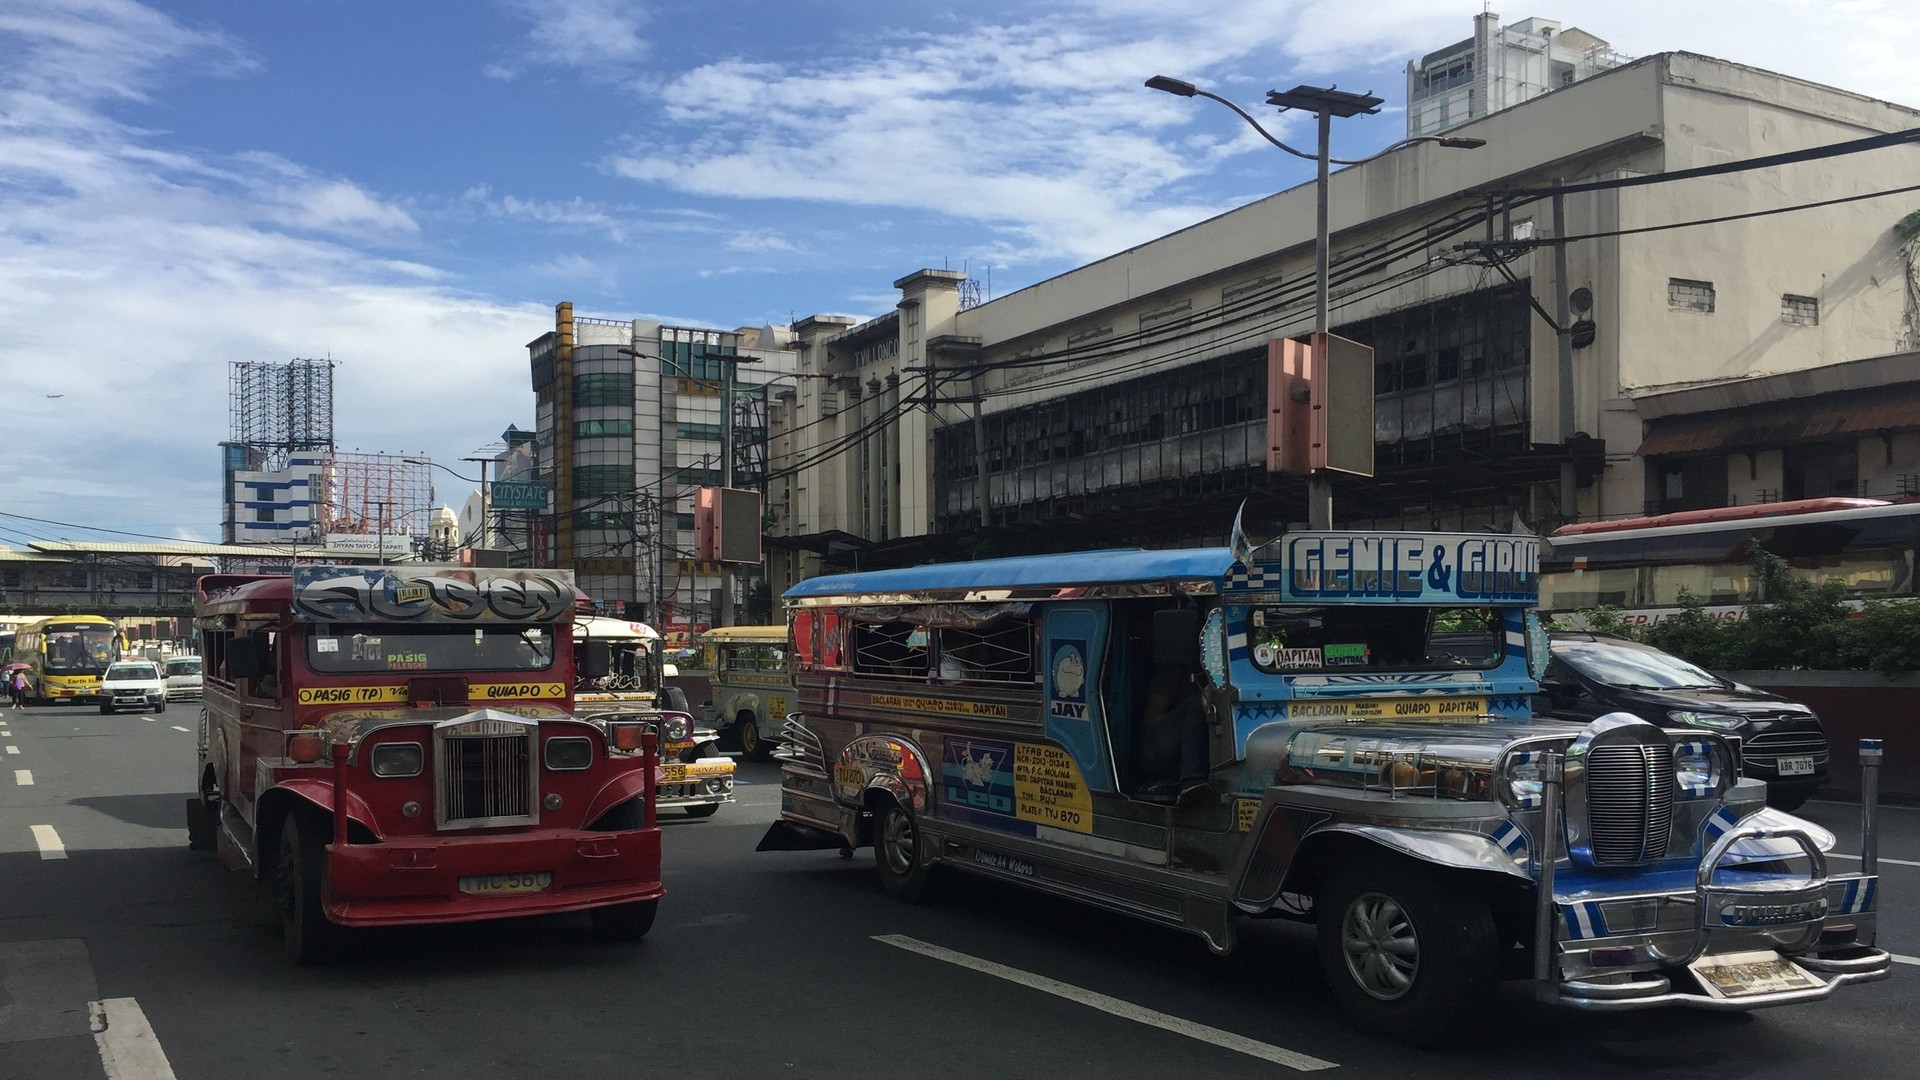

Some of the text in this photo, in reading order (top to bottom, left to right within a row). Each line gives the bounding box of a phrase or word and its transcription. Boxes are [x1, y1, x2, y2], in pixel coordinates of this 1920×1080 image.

[493, 484, 547, 500] CITYSTATE
[1290, 537, 1424, 598] GENIE
[1428, 544, 1452, 592] &
[387, 653, 428, 663] PASIG
[1276, 649, 1321, 665] DAPITAN
[1327, 655, 1365, 665] CENTRAL
[312, 689, 351, 702] PASIG
[355, 688, 384, 701] (TP)
[487, 685, 541, 699] QUIAPO
[872, 695, 901, 708] BACLARAN
[916, 698, 943, 711] QUIAPO
[974, 703, 1006, 717] DAPITAN
[1051, 702, 1086, 718] JAY
[1291, 701, 1480, 718] BACLARAN QUIAPO DAPITAN
[1351, 708, 1383, 716] HARRISON
[1016, 745, 1041, 757] LTFRB
[664, 766, 686, 777] 556
[1044, 768, 1070, 779] MOLINA
[1780, 761, 1794, 772] ABR
[1030, 776, 1054, 786] DAPITAN
[1055, 779, 1077, 791] MABINI
[1040, 786, 1073, 799] BACLARAN
[1040, 795, 1057, 806] PUJ
[1044, 806, 1059, 820] TYJ
[1060, 809, 1081, 825] 870
